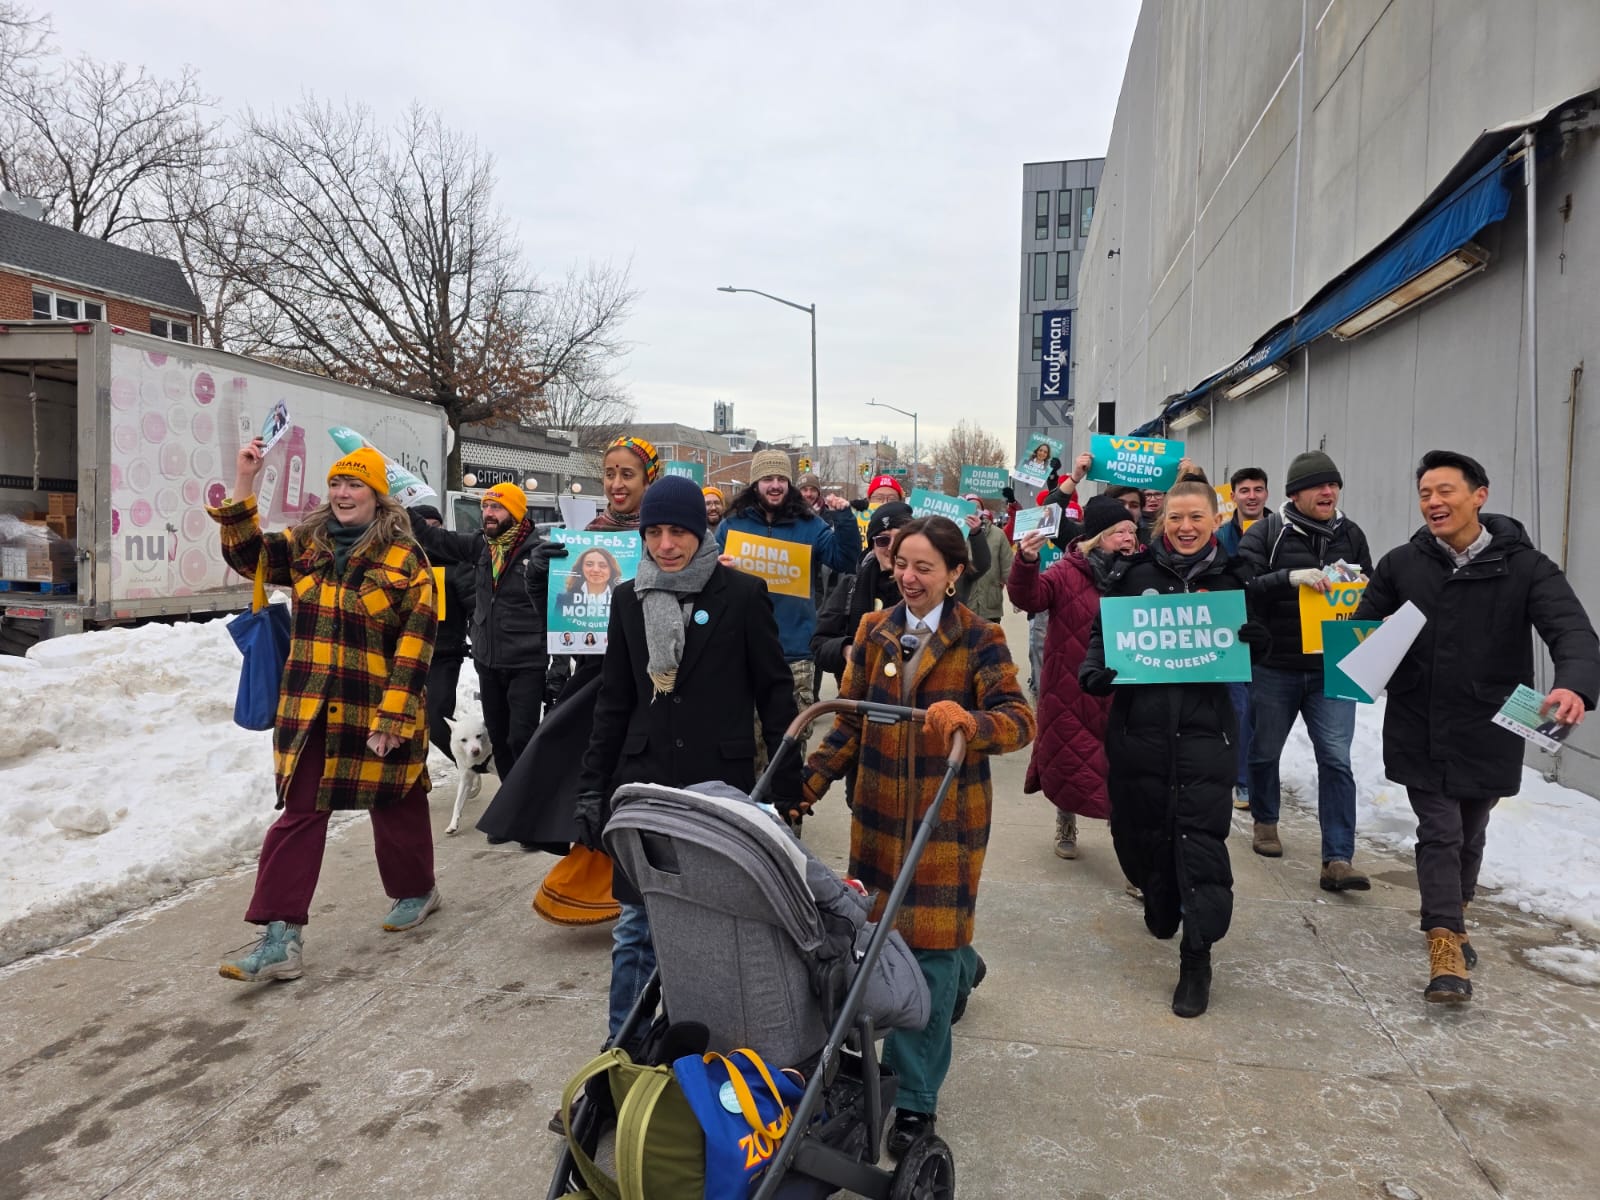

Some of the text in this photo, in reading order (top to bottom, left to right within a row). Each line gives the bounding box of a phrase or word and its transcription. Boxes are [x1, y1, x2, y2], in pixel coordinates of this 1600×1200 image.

[1043, 317, 1061, 395] Kaufman
[1109, 438, 1166, 454] VOTE
[1117, 451, 1155, 464] DIANA
[972, 470, 999, 480] DIANA
[1106, 460, 1163, 477] MORENO
[1113, 472, 1126, 481] FOR
[477, 470, 514, 484] CITRICO
[965, 478, 1005, 488] MORENO
[923, 497, 960, 515] DIANA
[125, 535, 164, 560] nu
[555, 534, 637, 548] Vote Feb. 3
[741, 542, 789, 563] DIANA
[1325, 588, 1365, 607] VO
[562, 605, 610, 617] MORE
[1132, 605, 1213, 628] DIANA
[572, 618, 587, 627] FOR
[1116, 627, 1234, 651] MORENO
[1134, 651, 1218, 670] FOR QUEENS
